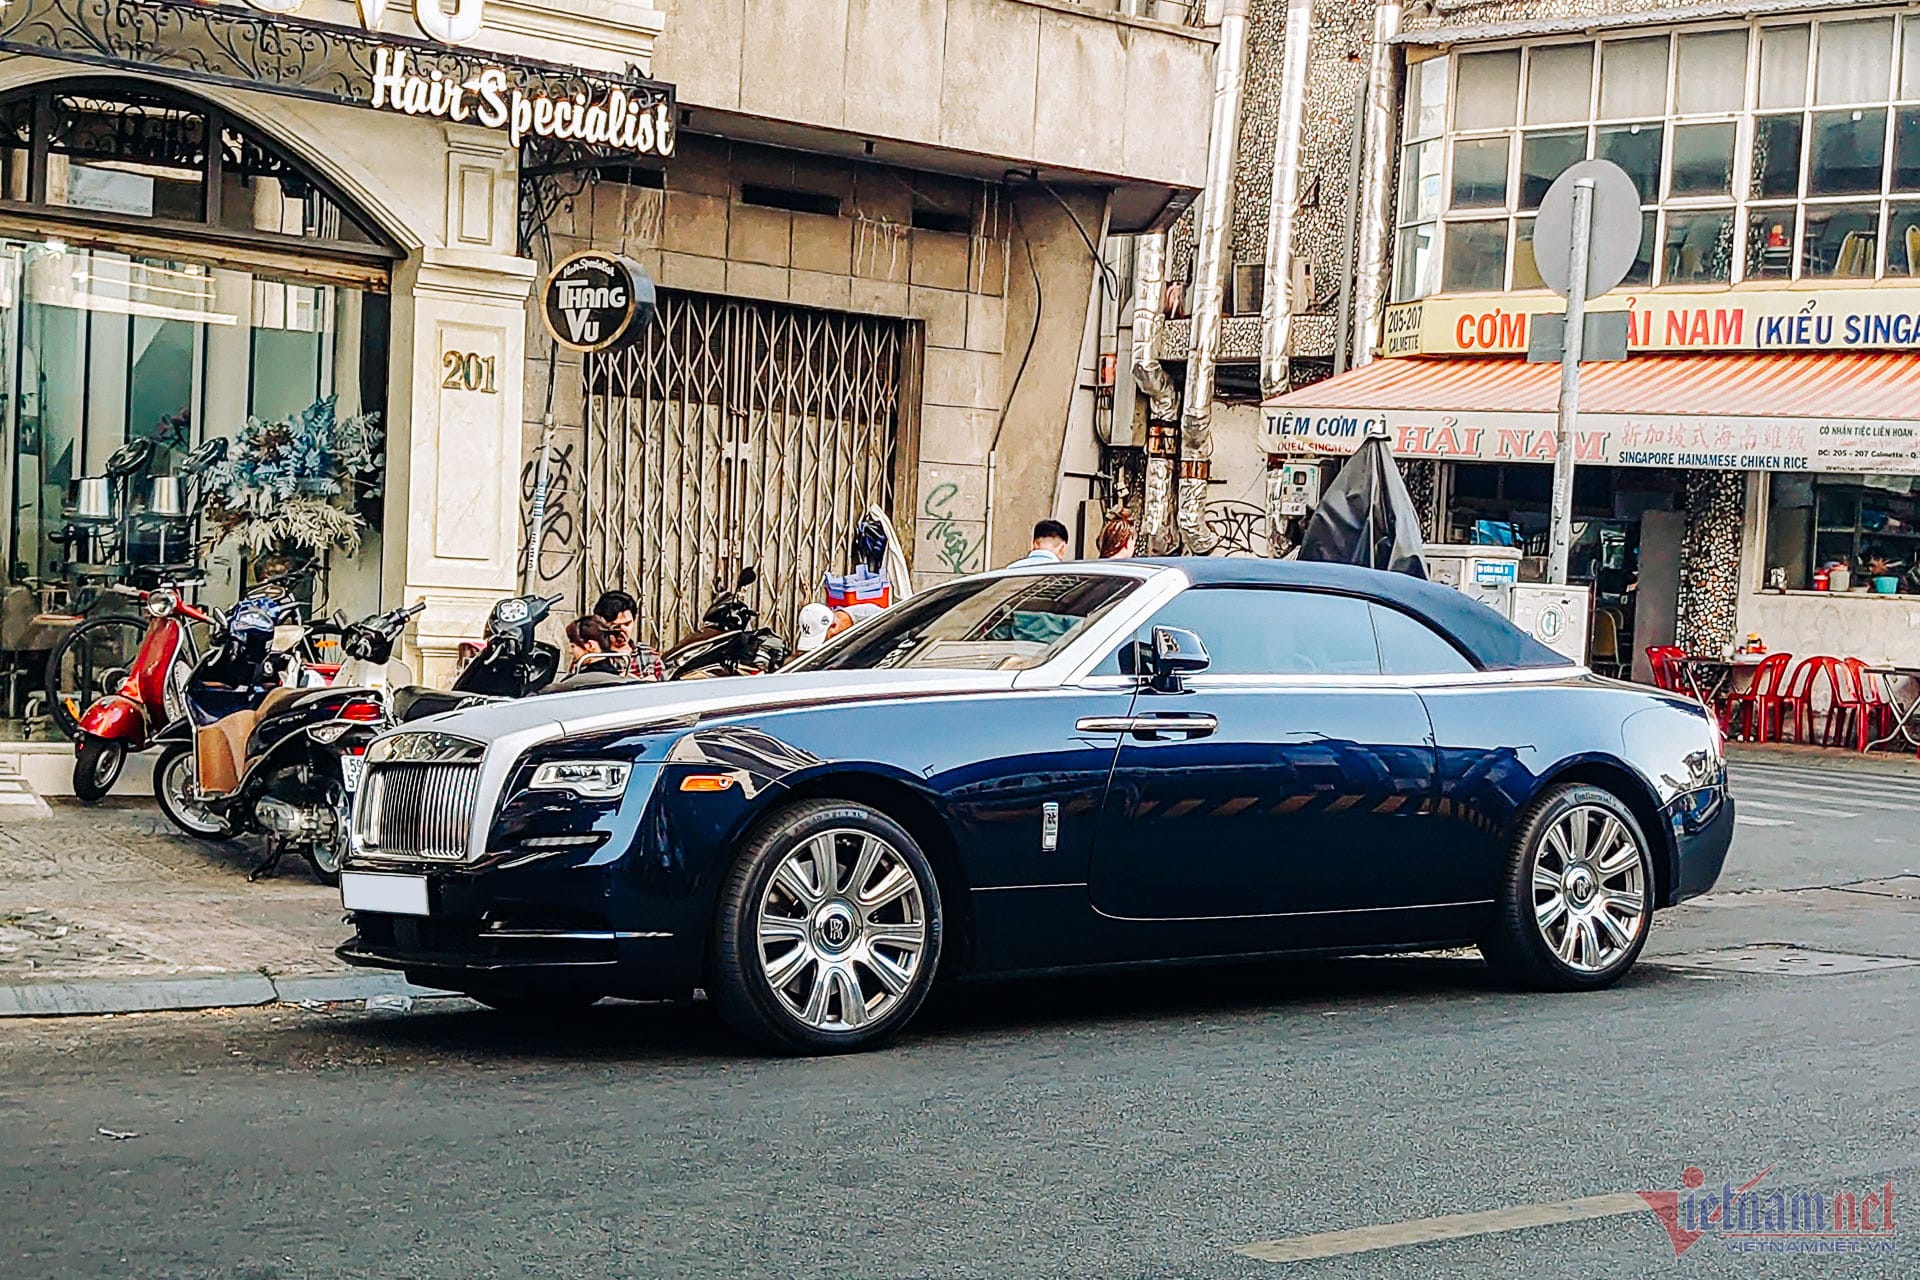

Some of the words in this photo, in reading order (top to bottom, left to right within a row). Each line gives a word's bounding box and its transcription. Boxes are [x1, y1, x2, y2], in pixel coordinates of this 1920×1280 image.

[370, 46, 470, 120] Hair
[476, 66, 675, 156] Specialist
[1388, 305, 1423, 334] 205-207
[1456, 308, 1526, 348] CƠM
[1665, 308, 1745, 346] NAM
[1756, 299, 1833, 348] (KIỂU
[1388, 334, 1420, 354] CALMETTE
[442, 349, 498, 394] 201
[1266, 411, 1310, 440] TIỆM
[1315, 414, 1358, 437] CƠM
[1394, 416, 1485, 459] HẢI
[1494, 429, 1612, 464] NAM
[1618, 451, 1675, 466] SINGAPORE
[1678, 454, 1738, 467] HAINAMESE
[1740, 455, 1780, 469] CHIKEN
[1783, 456, 1809, 470] RICE
